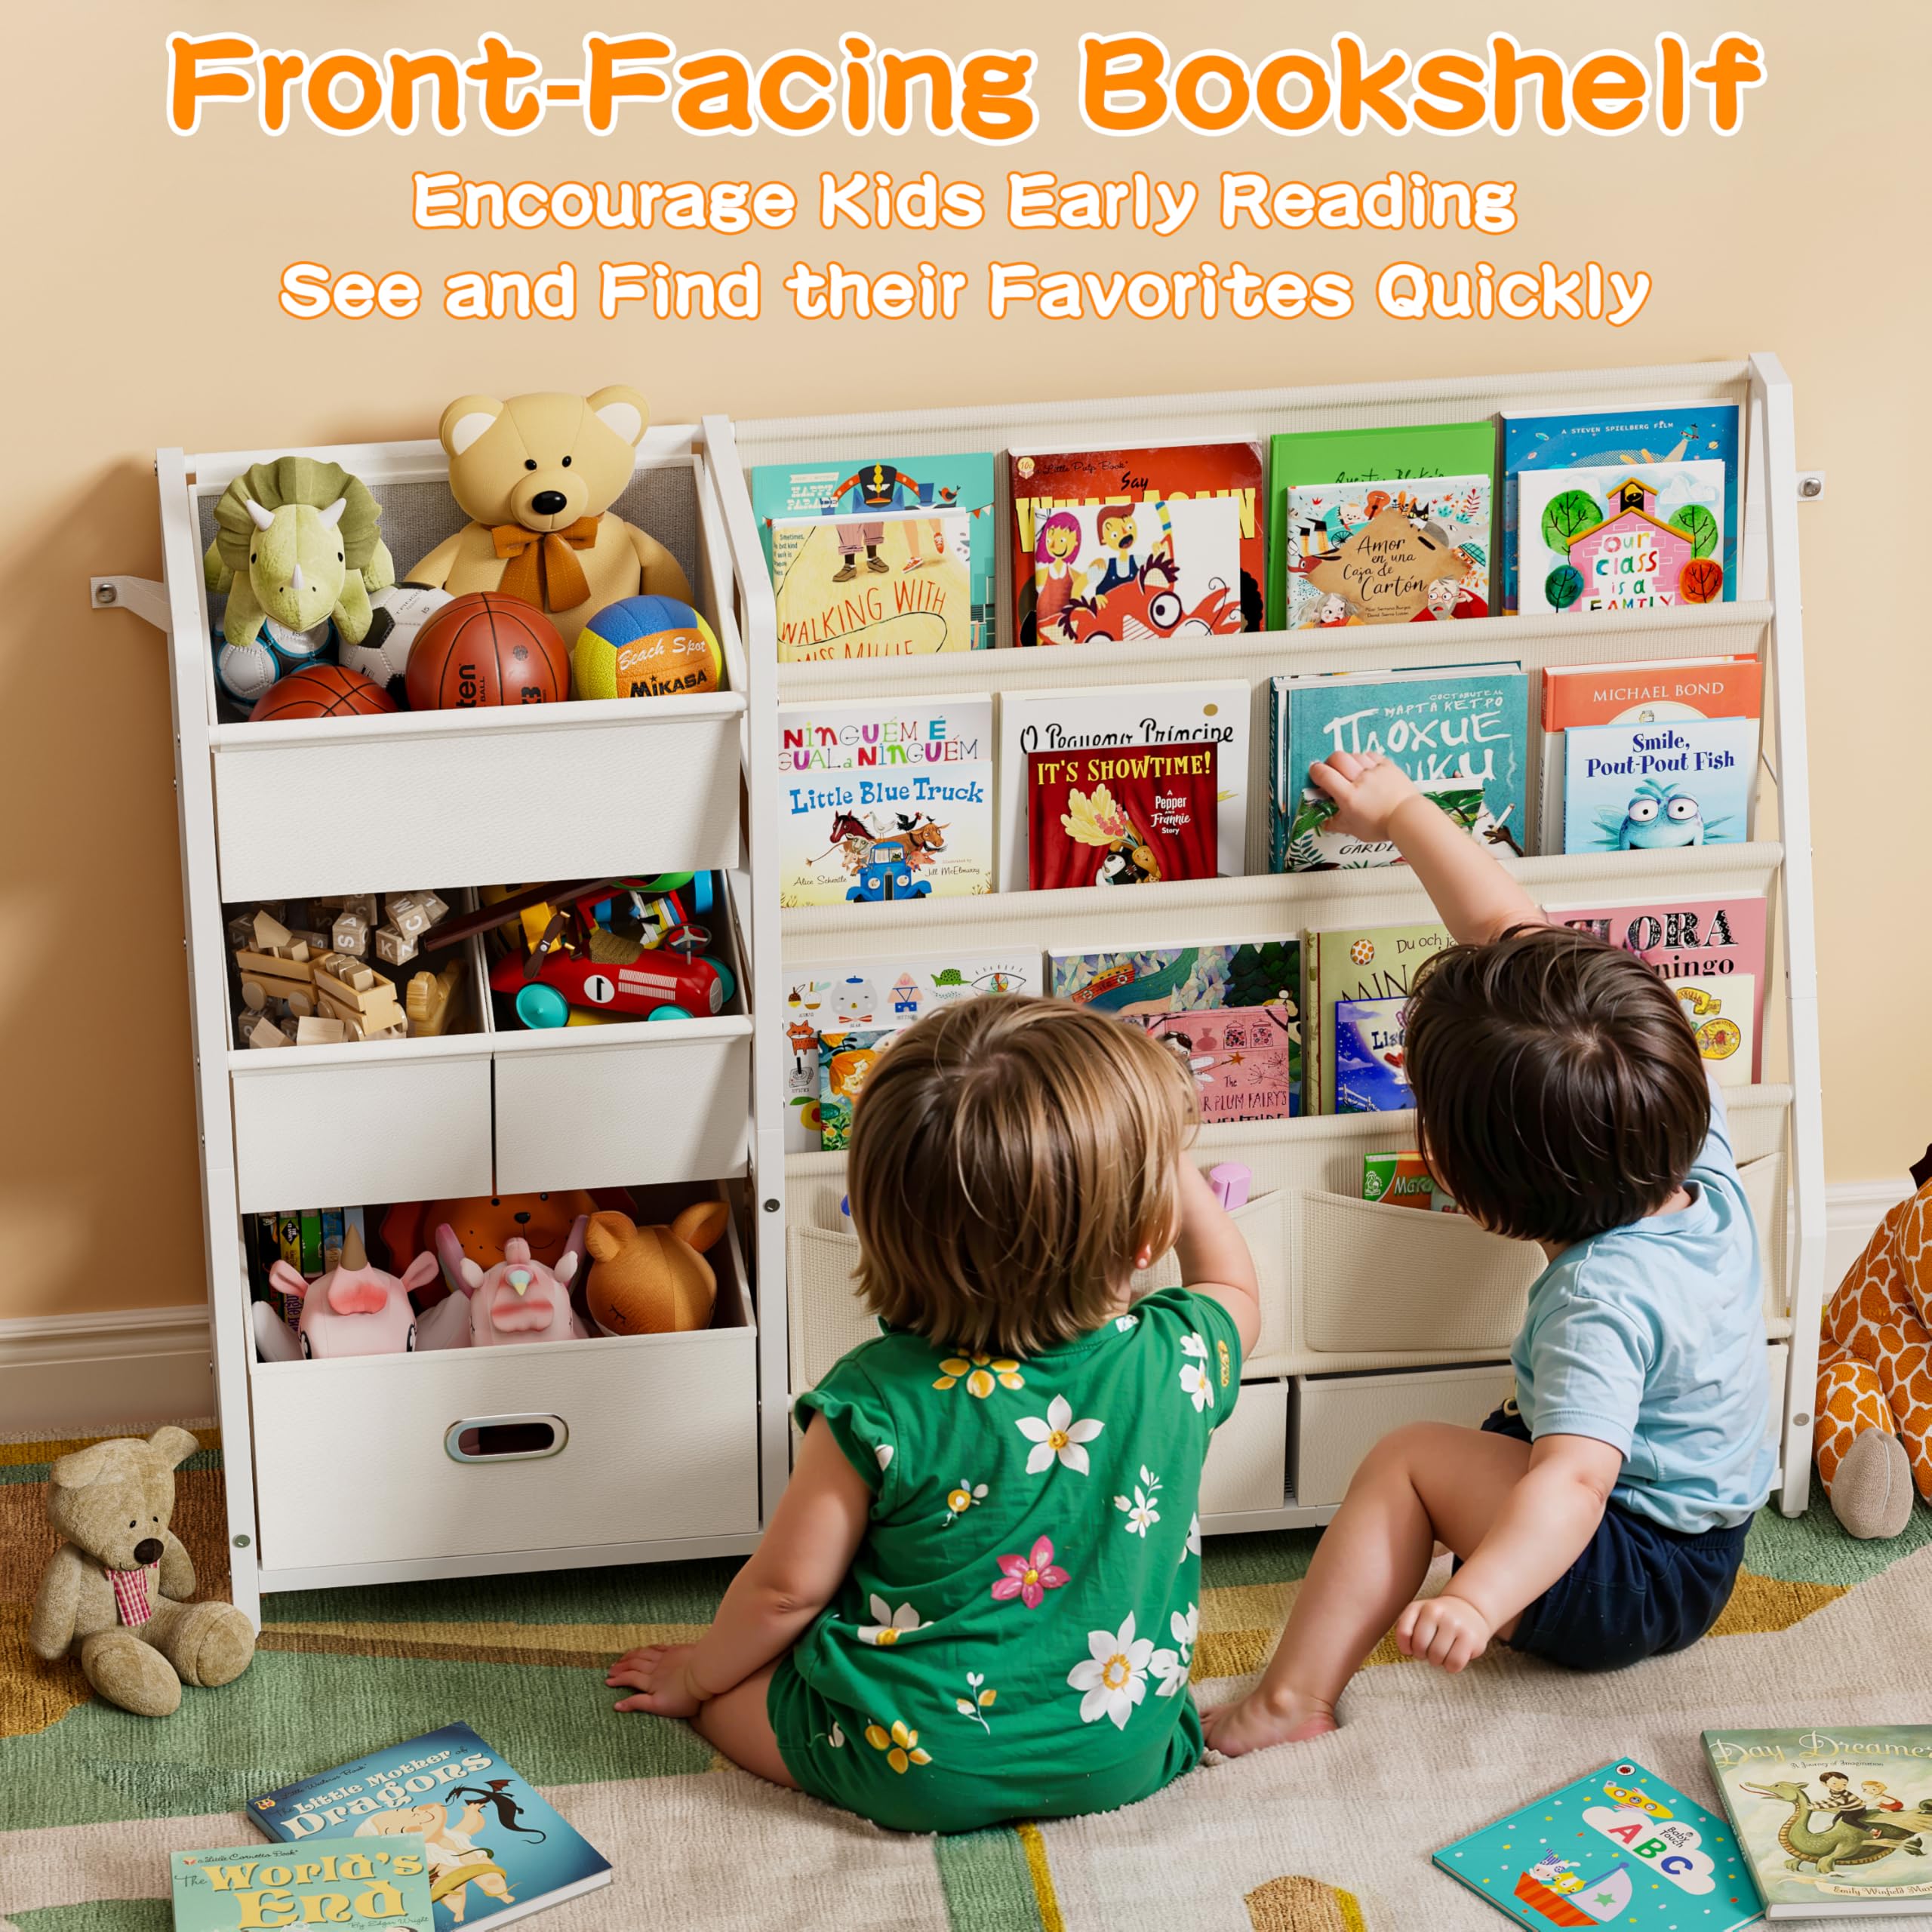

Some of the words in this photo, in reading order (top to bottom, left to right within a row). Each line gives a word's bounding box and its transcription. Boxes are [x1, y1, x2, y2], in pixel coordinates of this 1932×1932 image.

[1571, 426, 1601, 434] STEVEN
[1605, 423, 1649, 432] SPIELBERG
[791, 485, 833, 498] HAPPY
[1121, 471, 1149, 491] Say
[786, 497, 838, 511] PARADE
[1357, 535, 1406, 556] Amor
[1371, 554, 1387, 565] en
[1390, 552, 1417, 563] una
[1343, 566, 1374, 584] Caja
[1377, 563, 1394, 577] de
[1361, 575, 1430, 601] Cartón
[1633, 579, 1646, 595] a
[781, 587, 882, 645] WALKING
[894, 579, 946, 615] WITH
[618, 638, 665, 671] Beach
[456, 664, 477, 707] ten
[1593, 685, 1669, 703] MICHAEL
[1675, 681, 1724, 697] BOND
[1384, 702, 1438, 718] МАРТА
[1444, 697, 1503, 712] КЕТРО
[929, 715, 946, 740] É
[1632, 730, 1690, 753] Smile,
[843, 755, 854, 769] a
[1037, 761, 1078, 785] IT'S
[1088, 751, 1211, 782] SHOWTIME!
[1586, 754, 1689, 778] Pout-Pout
[1694, 750, 1736, 771] Fish
[789, 786, 854, 815] Little
[859, 781, 909, 805] Blue
[912, 777, 984, 804] Truck
[1155, 795, 1186, 810] Pepper
[1150, 813, 1191, 827] Frannie
[1161, 826, 1180, 835] Story
[793, 877, 814, 887] Alice
[1564, 909, 1739, 951] ORA
[381, 939, 393, 959] K
[1396, 940, 1415, 954] Du
[1419, 933, 1442, 946] och
[1223, 1075, 1238, 1088] The
[1214, 1093, 1244, 1111] PLUM
[1248, 1091, 1287, 1109] FAIRY'S
[1709, 1738, 1786, 1768] Day
[294, 1784, 364, 1814] Little
[365, 1749, 452, 1789] Mother
[455, 1746, 469, 1755] of
[281, 1753, 493, 1839] Dragons
[1660, 1830, 1684, 1848] Touch
[1667, 1826, 1690, 1841] Baby
[174, 1874, 208, 1887] The
[203, 1852, 424, 1893] World's
[1834, 1886, 1860, 1896] Emily
[233, 1880, 409, 1931] End
